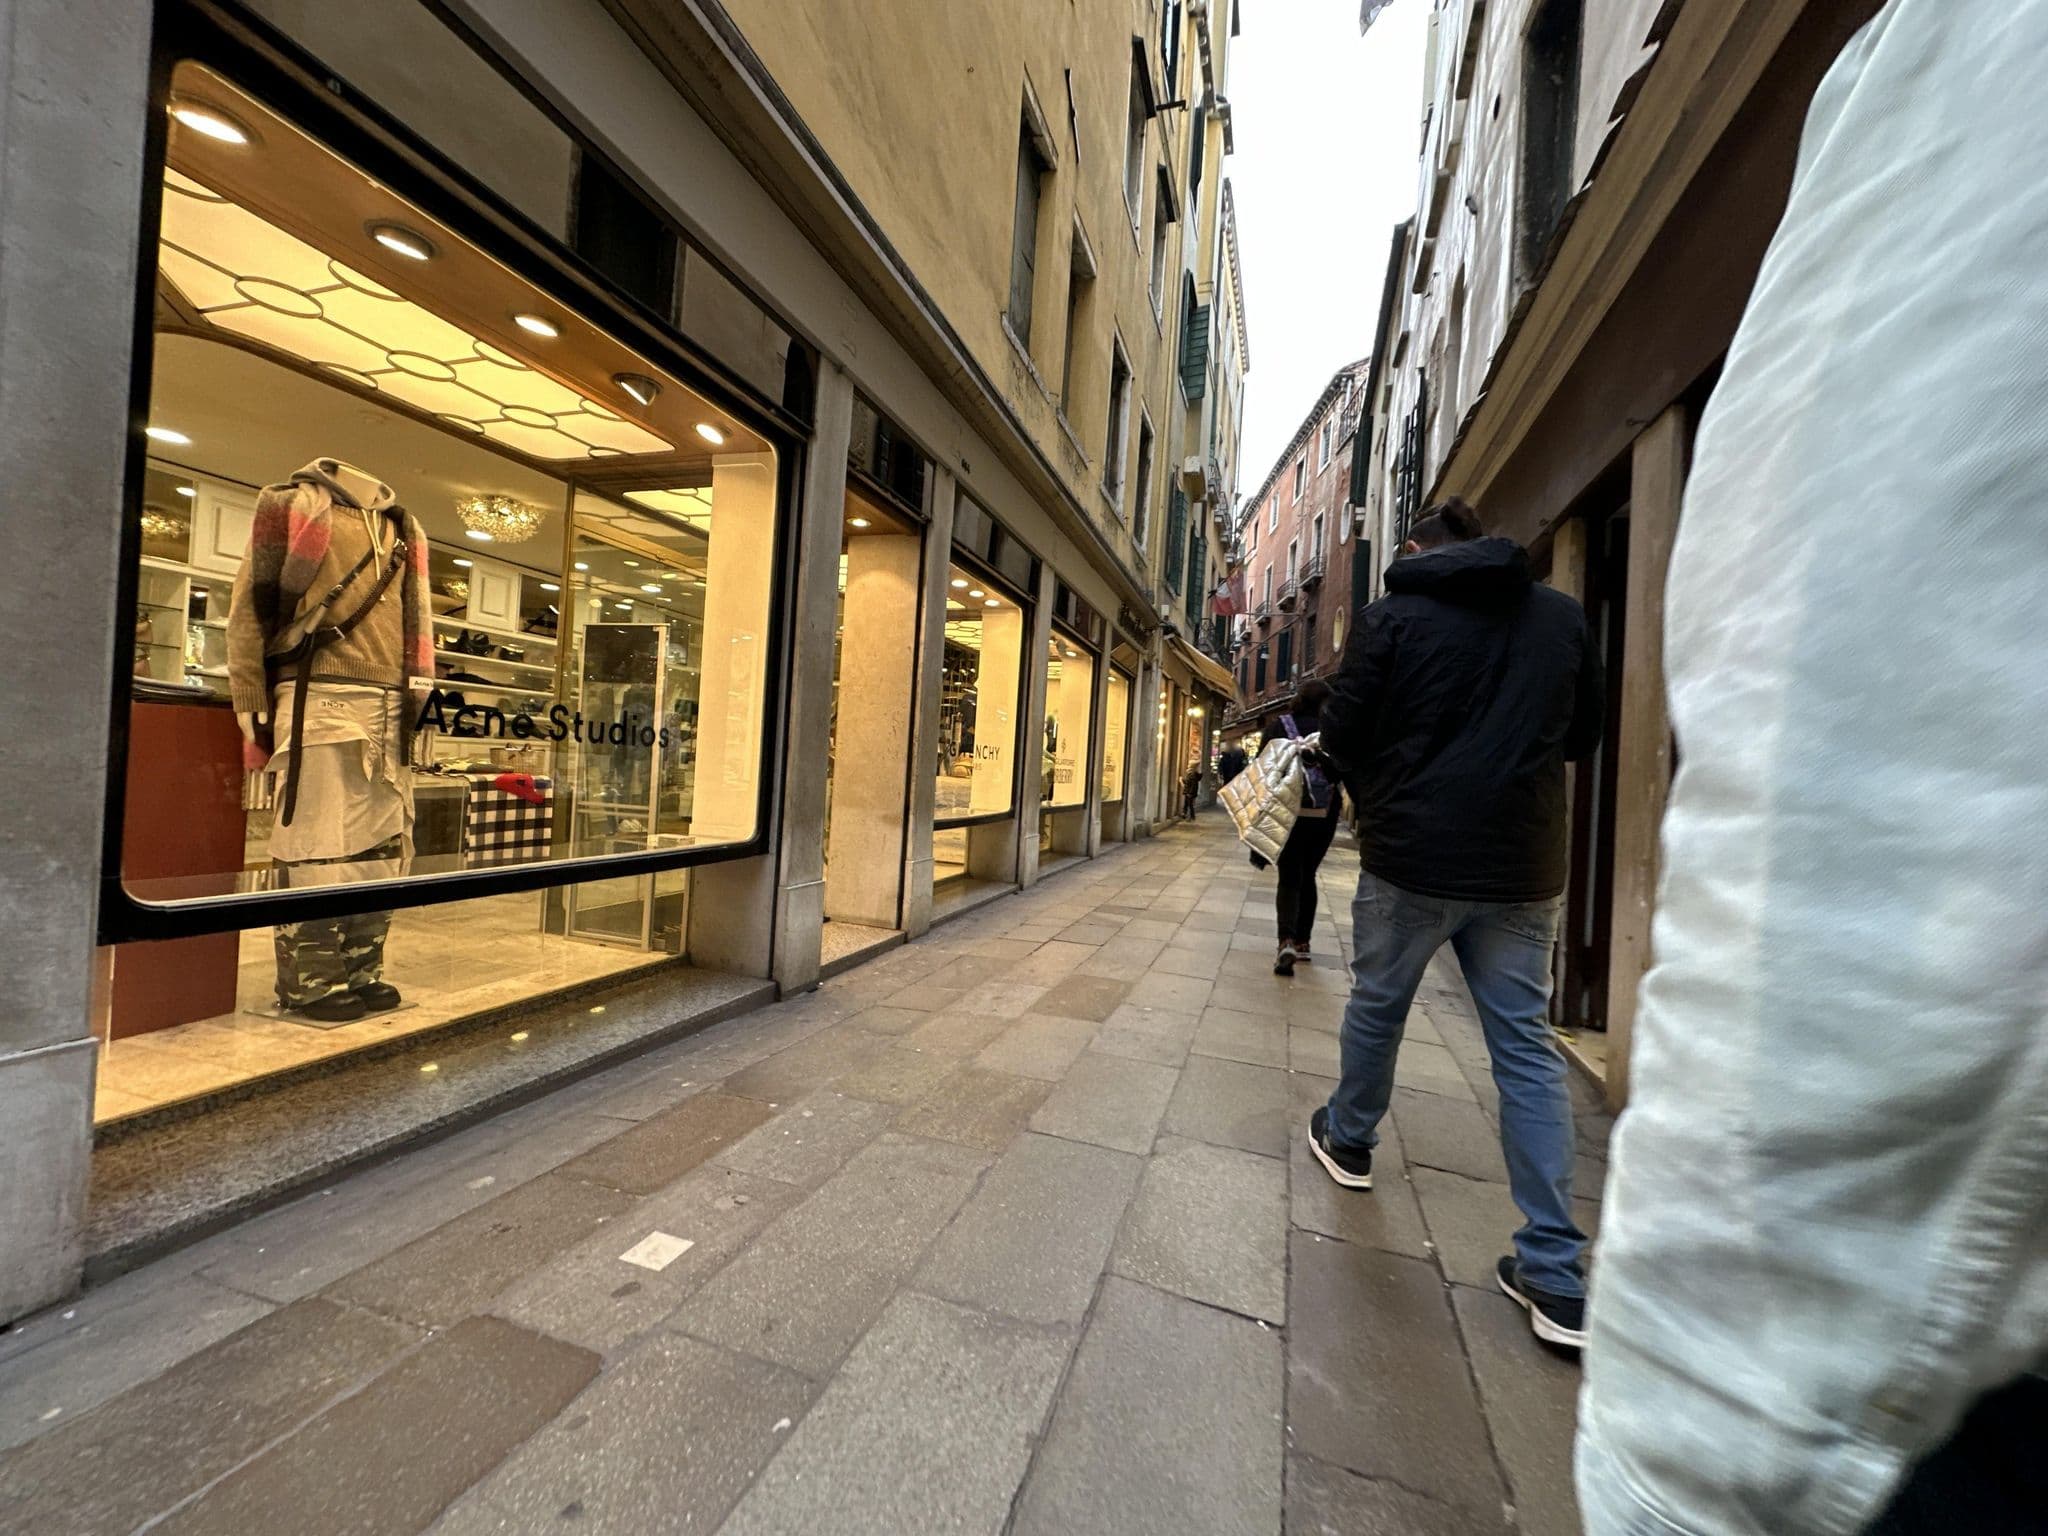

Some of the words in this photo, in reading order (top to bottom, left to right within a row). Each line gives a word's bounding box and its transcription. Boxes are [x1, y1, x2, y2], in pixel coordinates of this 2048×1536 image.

[414, 689, 534, 739] Acne
[549, 704, 669, 748] Studios
[949, 741, 1000, 761] GNCHY
